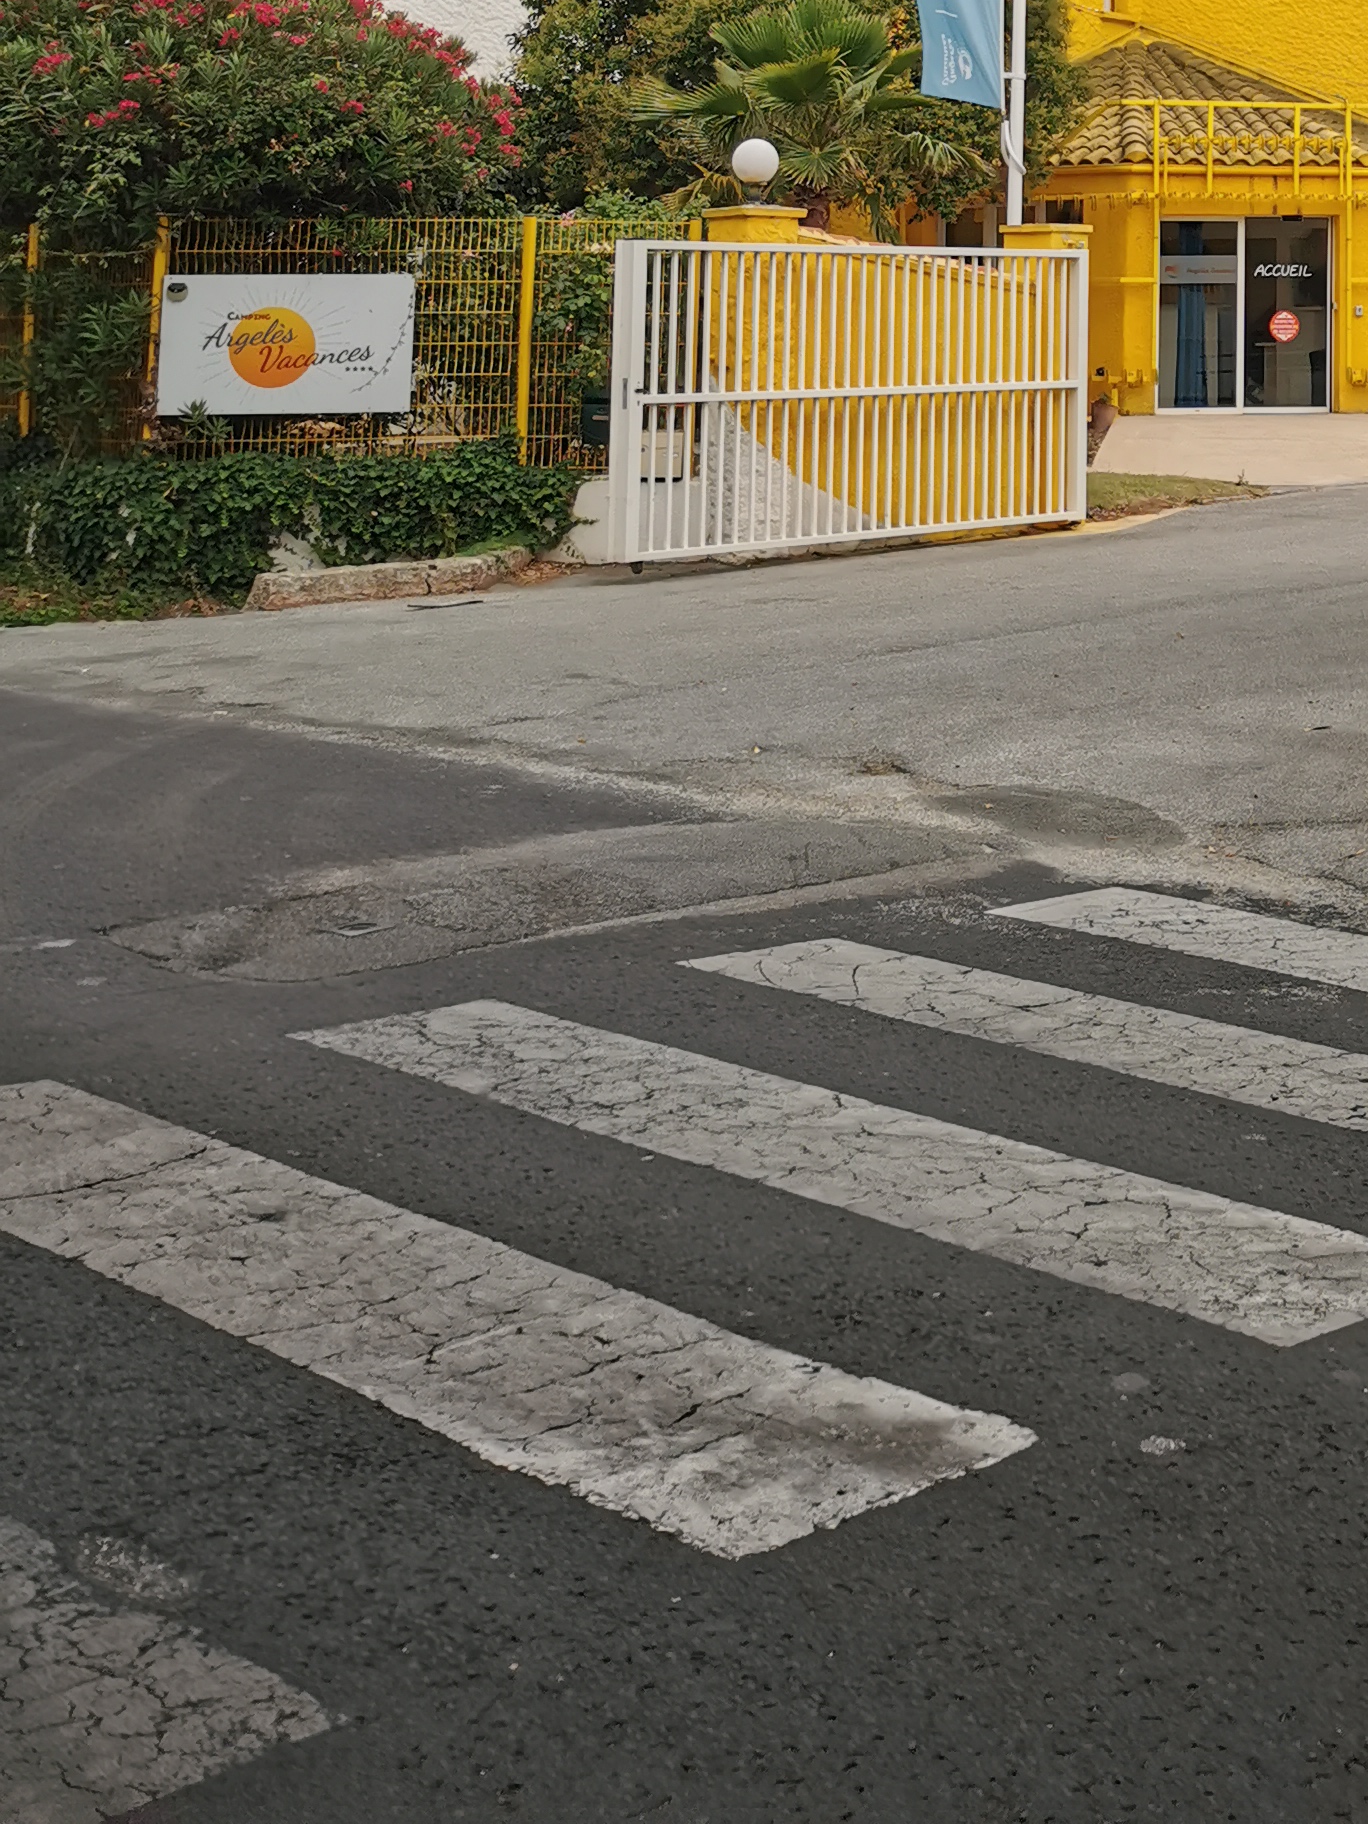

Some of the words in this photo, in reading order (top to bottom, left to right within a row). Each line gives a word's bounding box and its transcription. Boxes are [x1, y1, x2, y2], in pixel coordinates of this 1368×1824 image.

[1253, 264, 1313, 277] ACCUEIL
[202, 319, 298, 355] Argelès
[259, 345, 375, 374] Vacances
